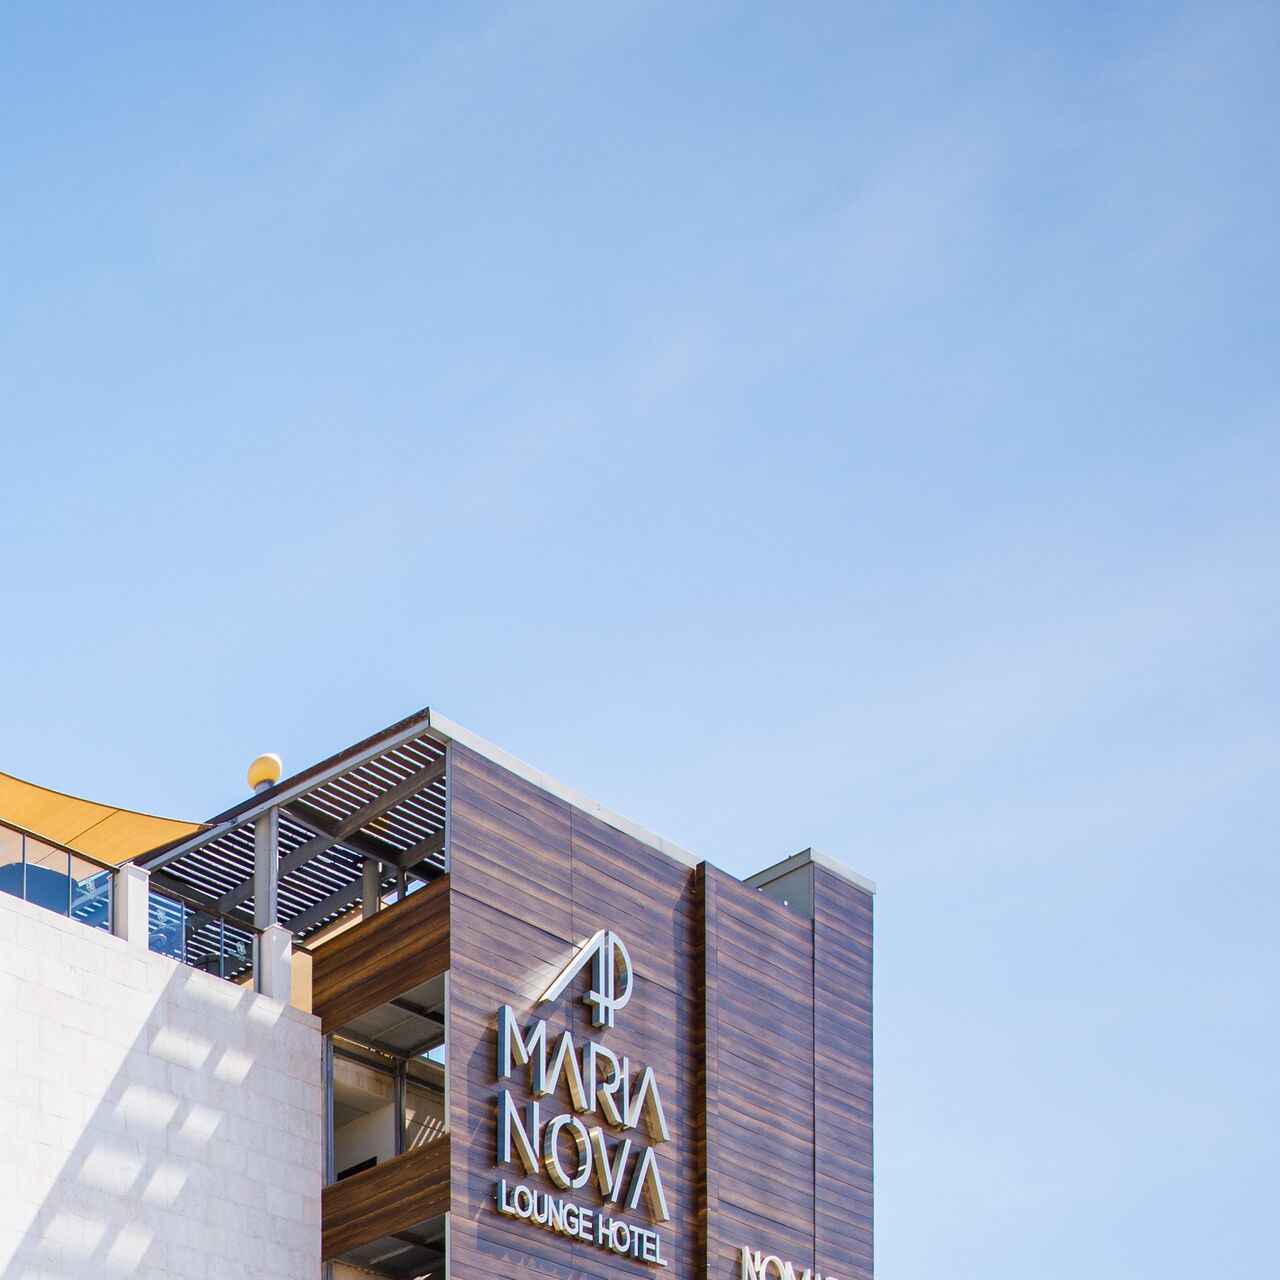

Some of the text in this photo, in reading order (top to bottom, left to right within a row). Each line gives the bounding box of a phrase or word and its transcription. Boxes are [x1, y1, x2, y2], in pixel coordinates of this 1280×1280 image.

[497, 1004, 670, 1143] MARIA
[497, 1089, 670, 1223] NOVA
[497, 1178, 668, 1266] LOUNGE HOTEL
